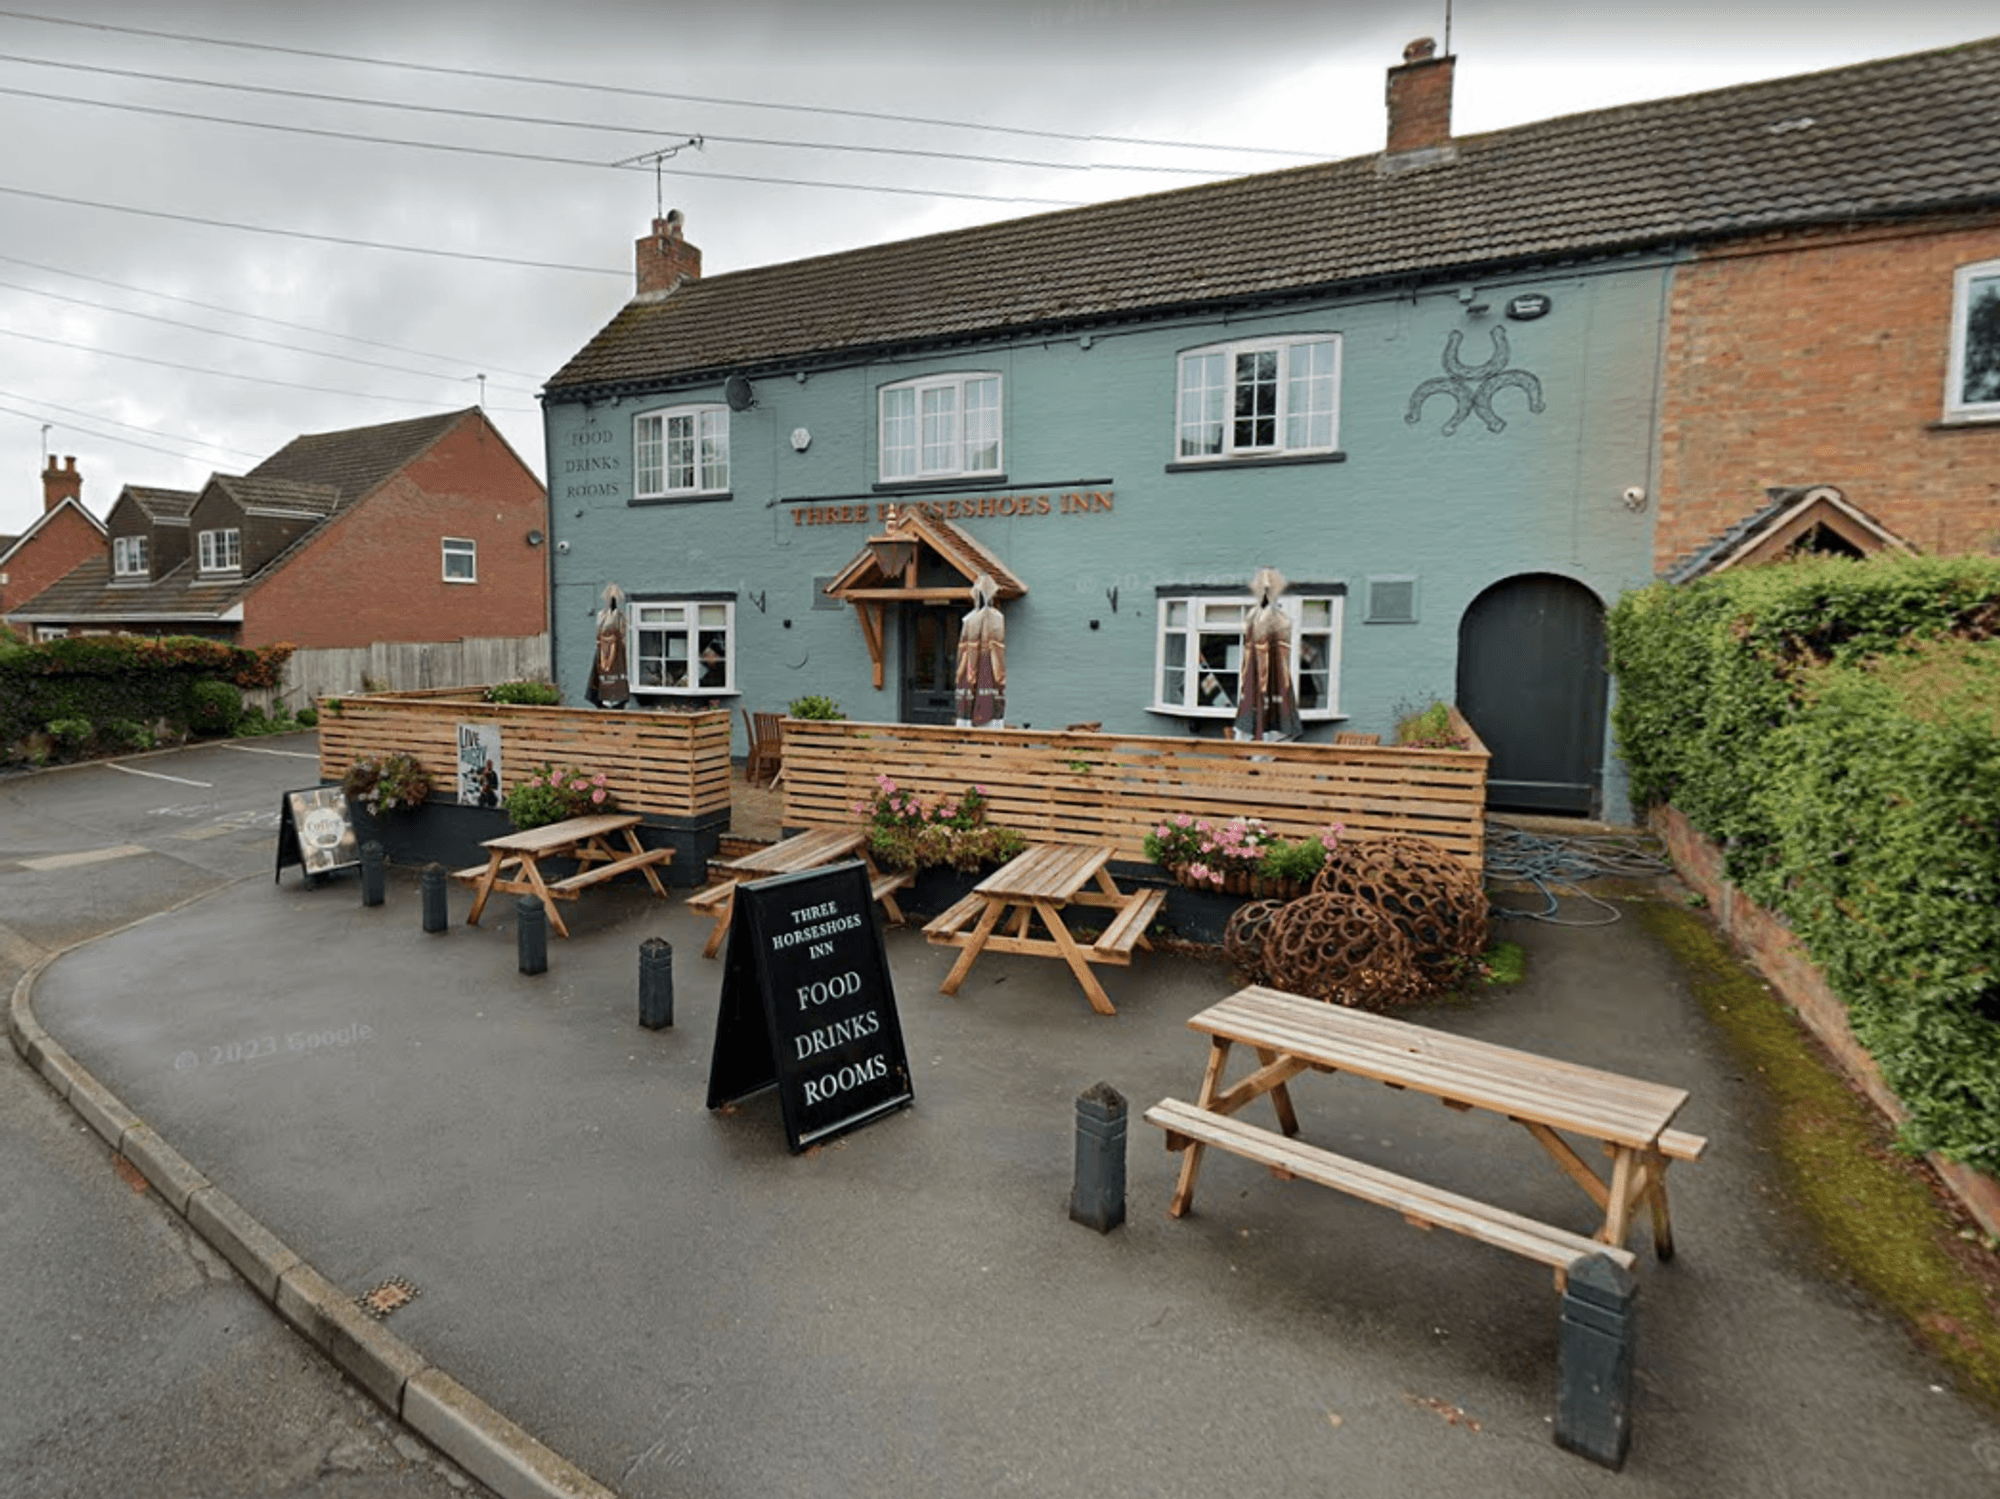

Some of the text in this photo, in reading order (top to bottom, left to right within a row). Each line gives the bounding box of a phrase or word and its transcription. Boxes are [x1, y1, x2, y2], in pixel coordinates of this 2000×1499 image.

[572, 430, 614, 447] FOOD
[565, 456, 621, 473] DRINKS
[566, 482, 620, 498] ROOMS
[791, 503, 869, 526] THREE
[1059, 490, 1115, 515] INN
[791, 901, 838, 924] THREE
[772, 913, 862, 950] HORSESHOES
[808, 941, 835, 960] INN
[797, 971, 862, 1011] FOOD
[794, 1010, 880, 1060] DRINKS
[803, 1054, 887, 1106] ROOMS
